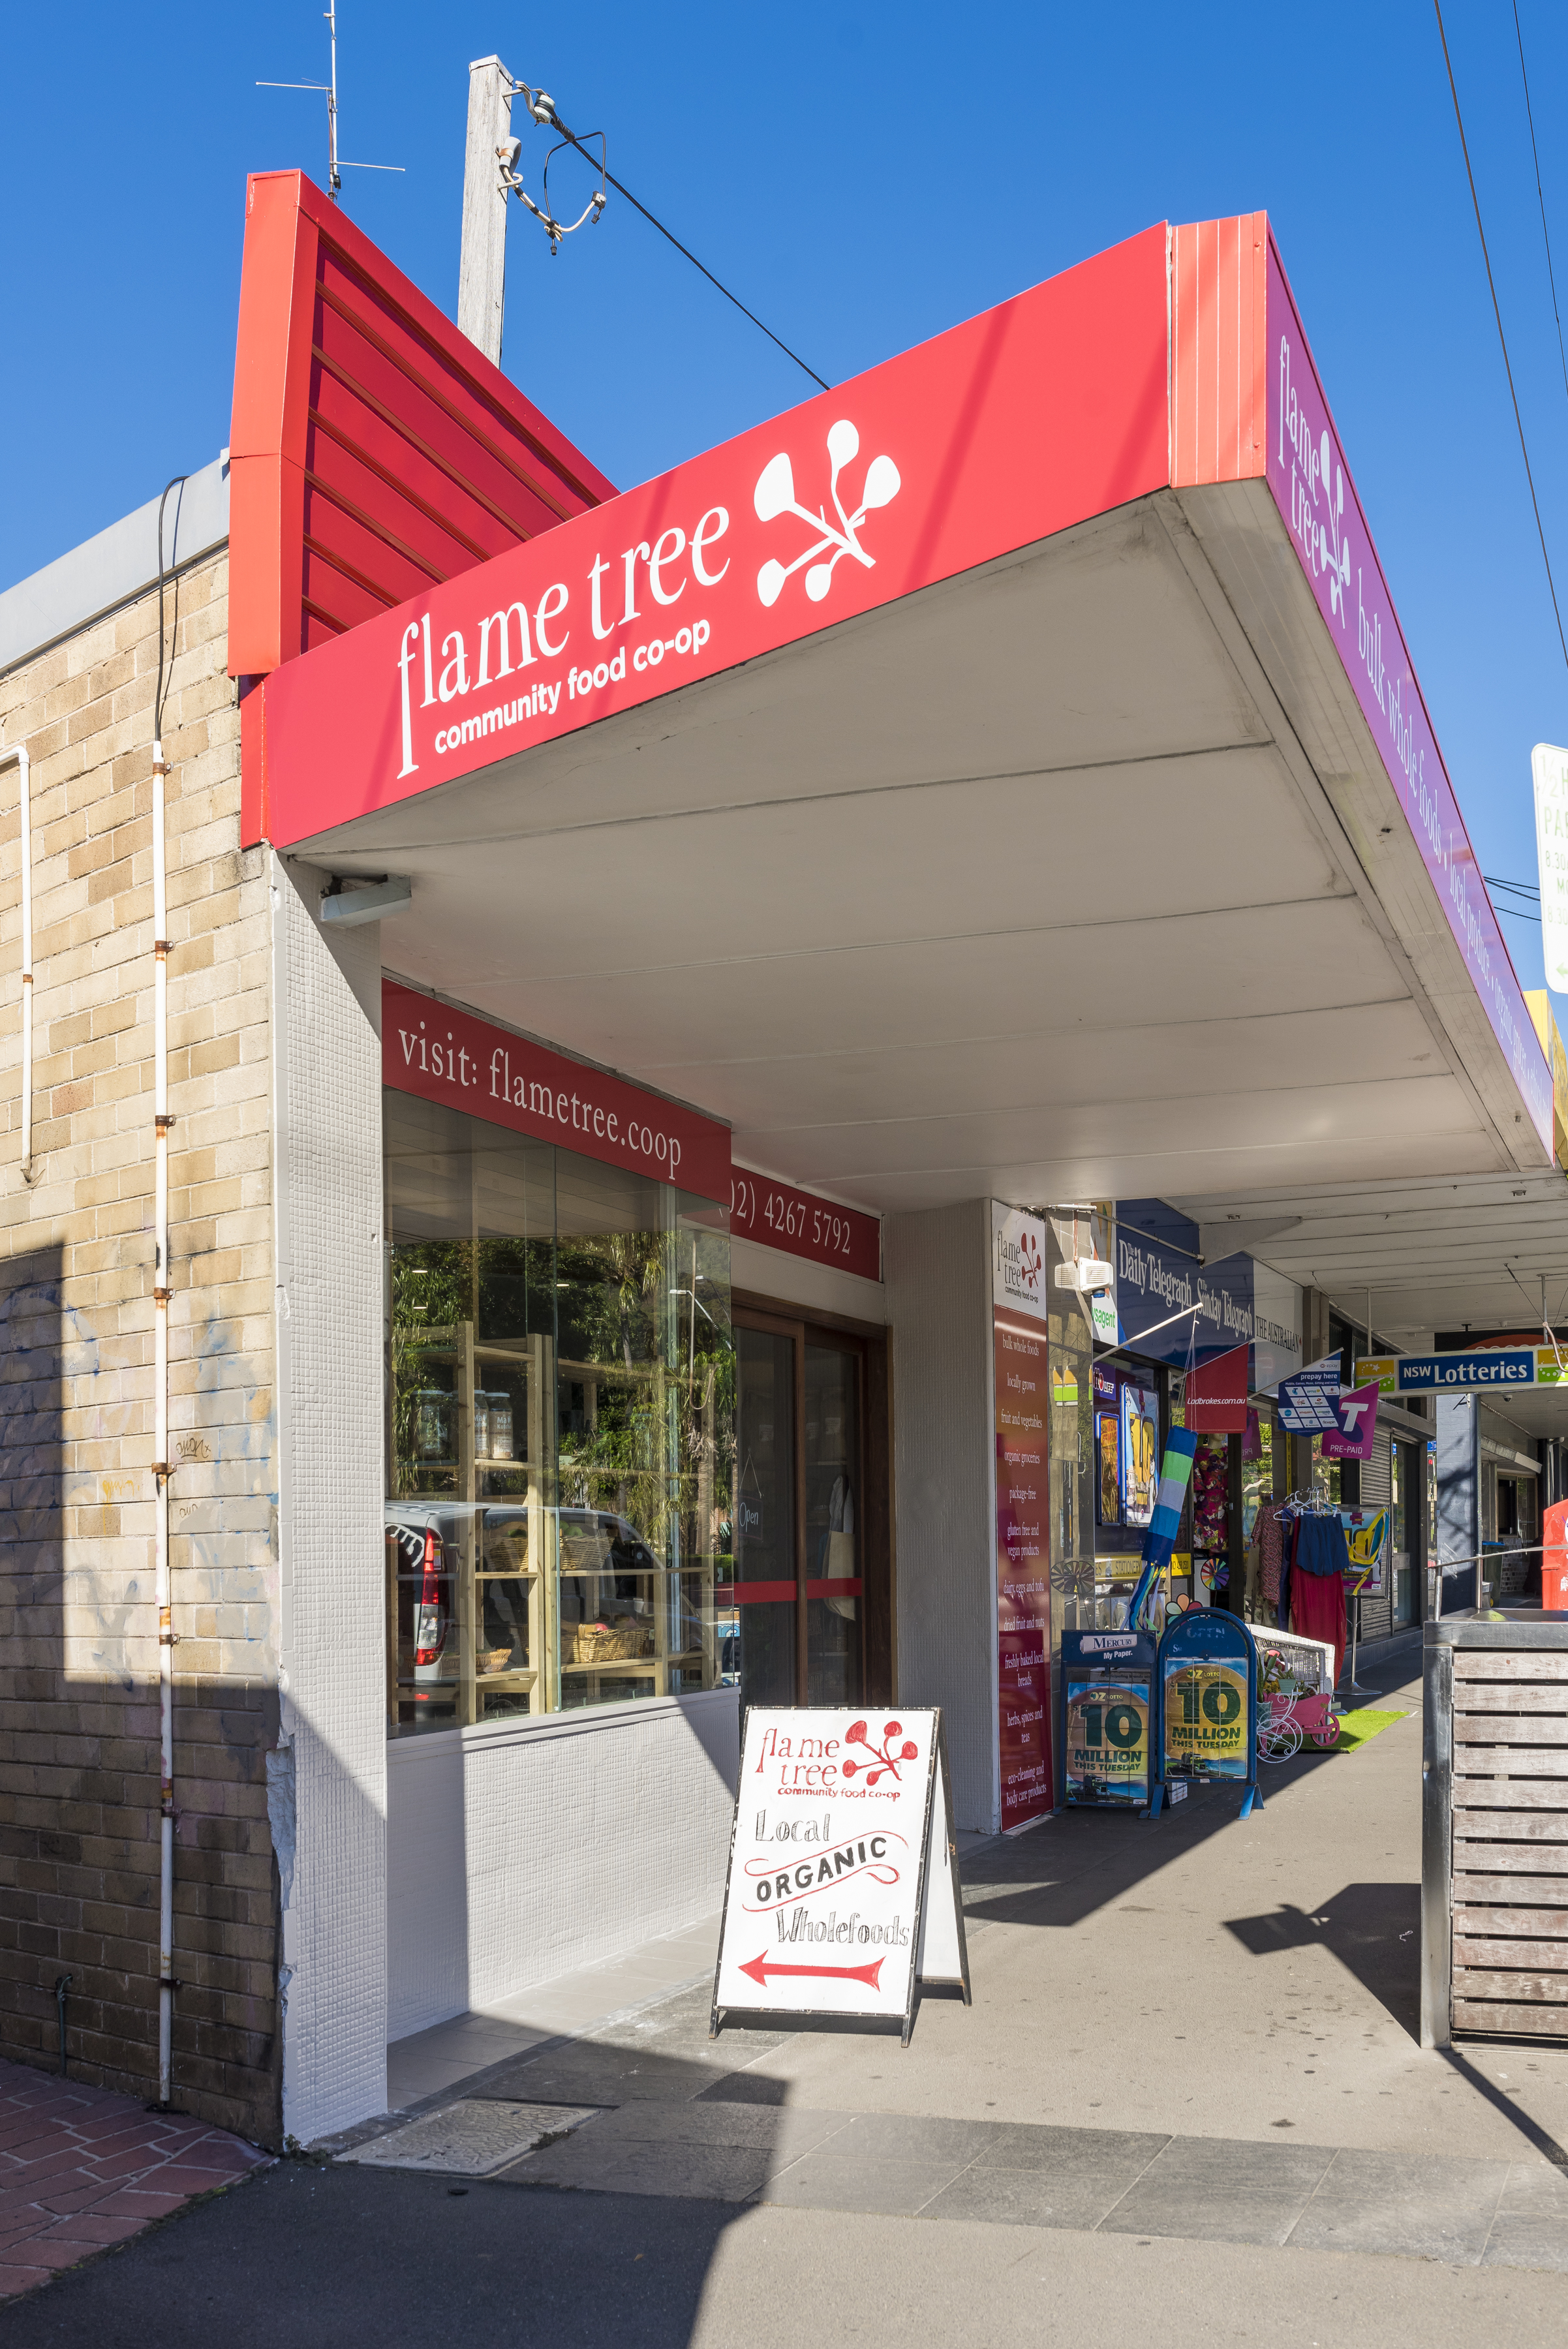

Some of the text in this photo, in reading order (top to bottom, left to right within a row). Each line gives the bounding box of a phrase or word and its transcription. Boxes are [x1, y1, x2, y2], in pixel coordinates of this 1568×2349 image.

[1278, 335, 1319, 506] flame
[1291, 457, 1319, 577] tree
[397, 506, 730, 779] flame tree
[435, 619, 711, 754] community food co-op
[1358, 566, 1385, 715] bulk
[1388, 678, 1417, 798] whole
[1419, 749, 1441, 864] foods
[1450, 832, 1466, 929] local
[1468, 902, 1490, 987] produce
[1495, 977, 1513, 1045] organic
[1546, 850, 1568, 871] 8.30
[398, 1021, 681, 1180] visit: flametree.coop
[764, 1193, 806, 1238] 4267
[812, 1210, 850, 1254] 5792
[997, 1230, 1021, 1271] flame
[1005, 1261, 1021, 1287] tree
[1119, 1239, 1192, 1312] Daily Telegraph
[1006, 1286, 1022, 1299] community
[1030, 1295, 1039, 1304] co-op
[1197, 1278, 1252, 1341] Sunday Telegraph
[1002, 1334, 1039, 1357] bulk whole foods
[1255, 1315, 1299, 1354] THE AUSTRALIAN
[1007, 1372, 1036, 1394] locally grown
[1404, 1361, 1528, 1383] NSW Lotteries
[1001, 1409, 1043, 1433] fruit and vegetables
[1004, 1449, 1040, 1467] organic groceries
[1330, 1445, 1363, 1454] PRE-PAID
[1009, 1485, 1036, 1503] package-free
[739, 1502, 758, 1532] Open
[1007, 1522, 1021, 1541] gluten
[1030, 1522, 1039, 1535] and
[1007, 1542, 1039, 1561] vegan products
[1115, 1560, 1141, 1574] STATIONERY
[1004, 1578, 1044, 1599] dairy, eggs and tofu
[1004, 1618, 1015, 1631] dried
[1016, 1616, 1025, 1630] fruit
[1036, 1618, 1044, 1627] nuts
[1093, 1638, 1132, 1650] MERCURY
[1005, 1650, 1043, 1671] freshly baked local
[1017, 1672, 1032, 1687] breads
[1187, 1669, 1203, 1680] OZ
[1090, 1692, 1107, 1702] OZ
[1007, 1705, 1043, 1727] herbs, spices and
[1021, 1732, 1030, 1743] teas
[1171, 1727, 1240, 1740] MILLION
[1171, 1740, 1239, 1748] THIS TUESDAY
[755, 1728, 840, 1773] flame
[1074, 1749, 1142, 1763] MILLION
[780, 1762, 837, 1787] tree
[1008, 1766, 1036, 1785] eco-cleaning
[1074, 1762, 1141, 1772] THIS TUESDAY
[777, 1787, 900, 1802] community food co-op
[1006, 1782, 1047, 1807] body care products
[755, 1809, 830, 1841] Local
[757, 1837, 887, 1902] ORGANIC
[776, 1907, 910, 1946] Wholefoods
